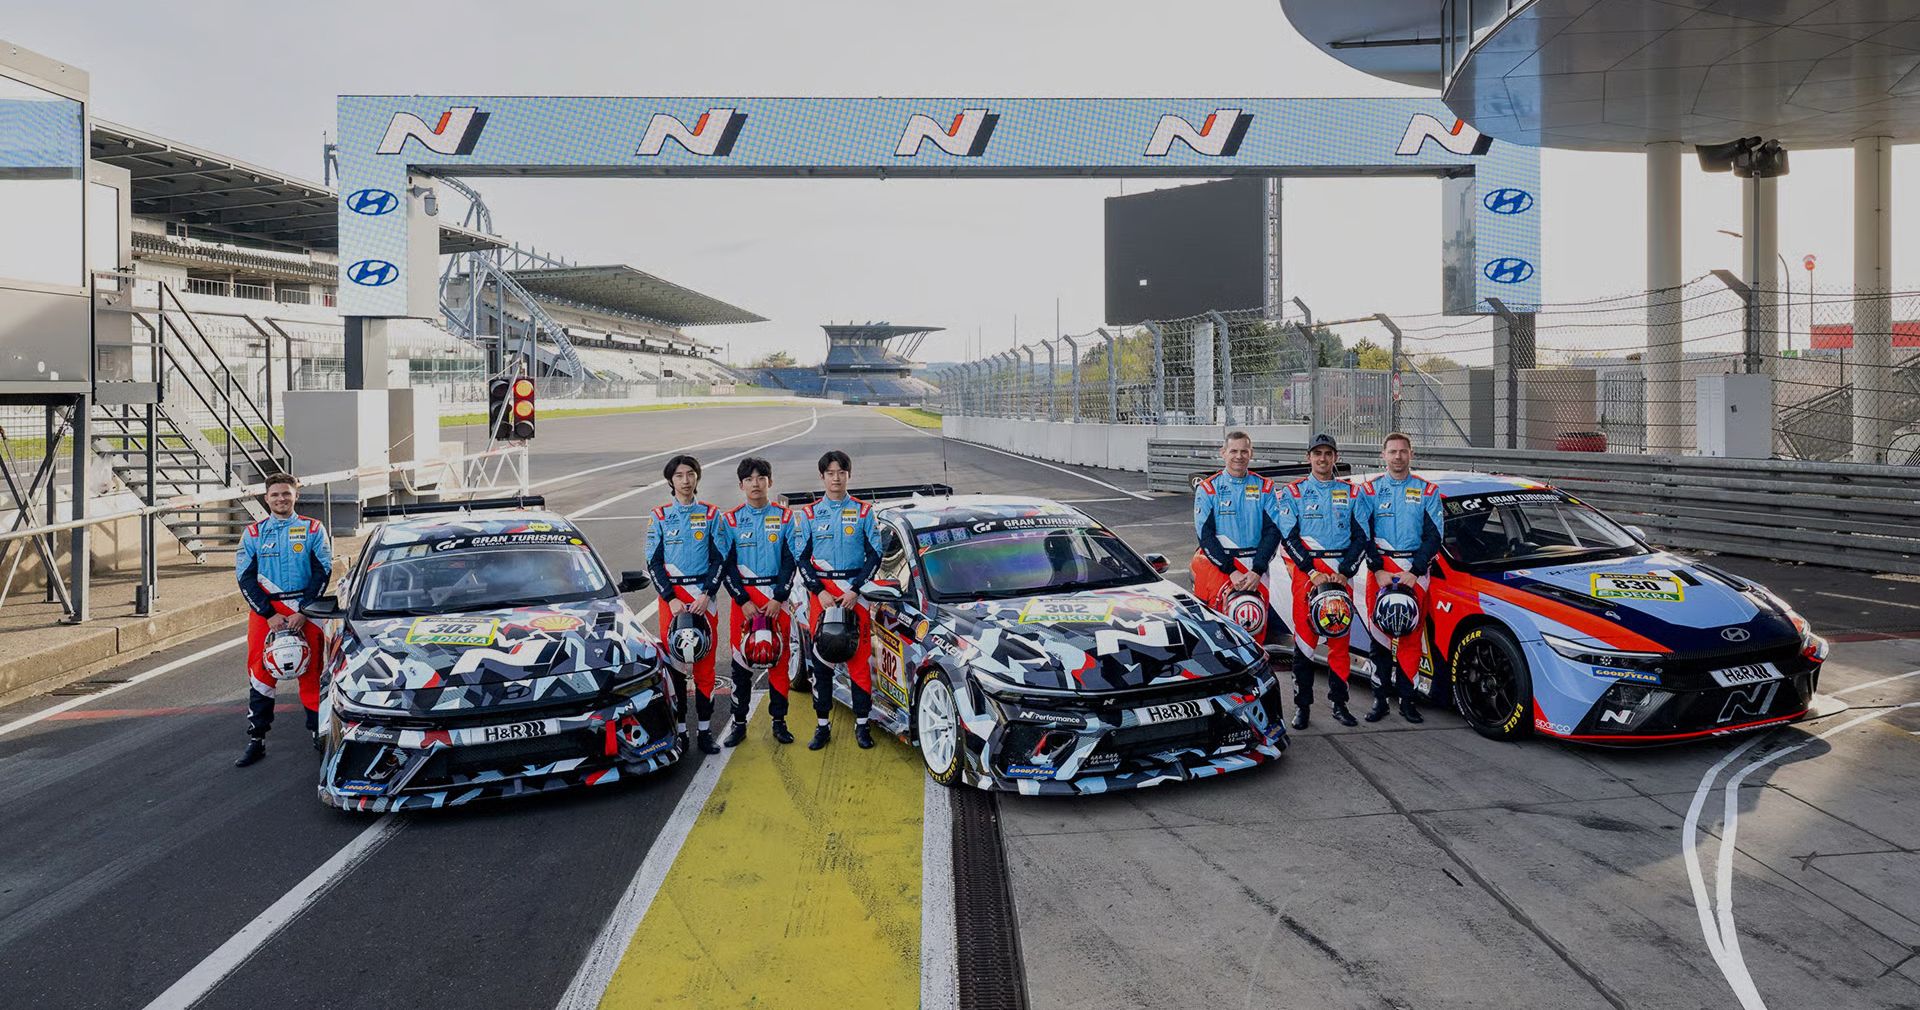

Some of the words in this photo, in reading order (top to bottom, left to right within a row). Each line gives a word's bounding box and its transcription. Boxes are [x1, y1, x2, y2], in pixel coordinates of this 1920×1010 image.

[375, 106, 491, 155] N
[635, 107, 748, 156] N
[893, 108, 1000, 156] N
[1143, 108, 1254, 156] N
[1487, 494, 1517, 504] GRAN
[1003, 519, 1035, 527] GRAN
[471, 536, 507, 544] GRAN
[511, 534, 566, 542] TURISMO
[1612, 580, 1661, 591] 830
[1620, 591, 1675, 600] DEKRA
[1044, 604, 1090, 613] 302
[429, 623, 477, 634] 303
[437, 635, 486, 644] DEKRA
[1452, 630, 1482, 682] GOODYEAR
[881, 648, 897, 682] 302
[1596, 669, 1657, 681] GOODYEAR
[1035, 713, 1080, 723] Performance
[1148, 704, 1183, 721] H&R
[1503, 702, 1524, 733] EAGLE
[1600, 709, 1635, 724] N
[1535, 718, 1571, 732] sparco
[486, 724, 522, 741] H&R
[1010, 768, 1055, 776] GOODYEAR
